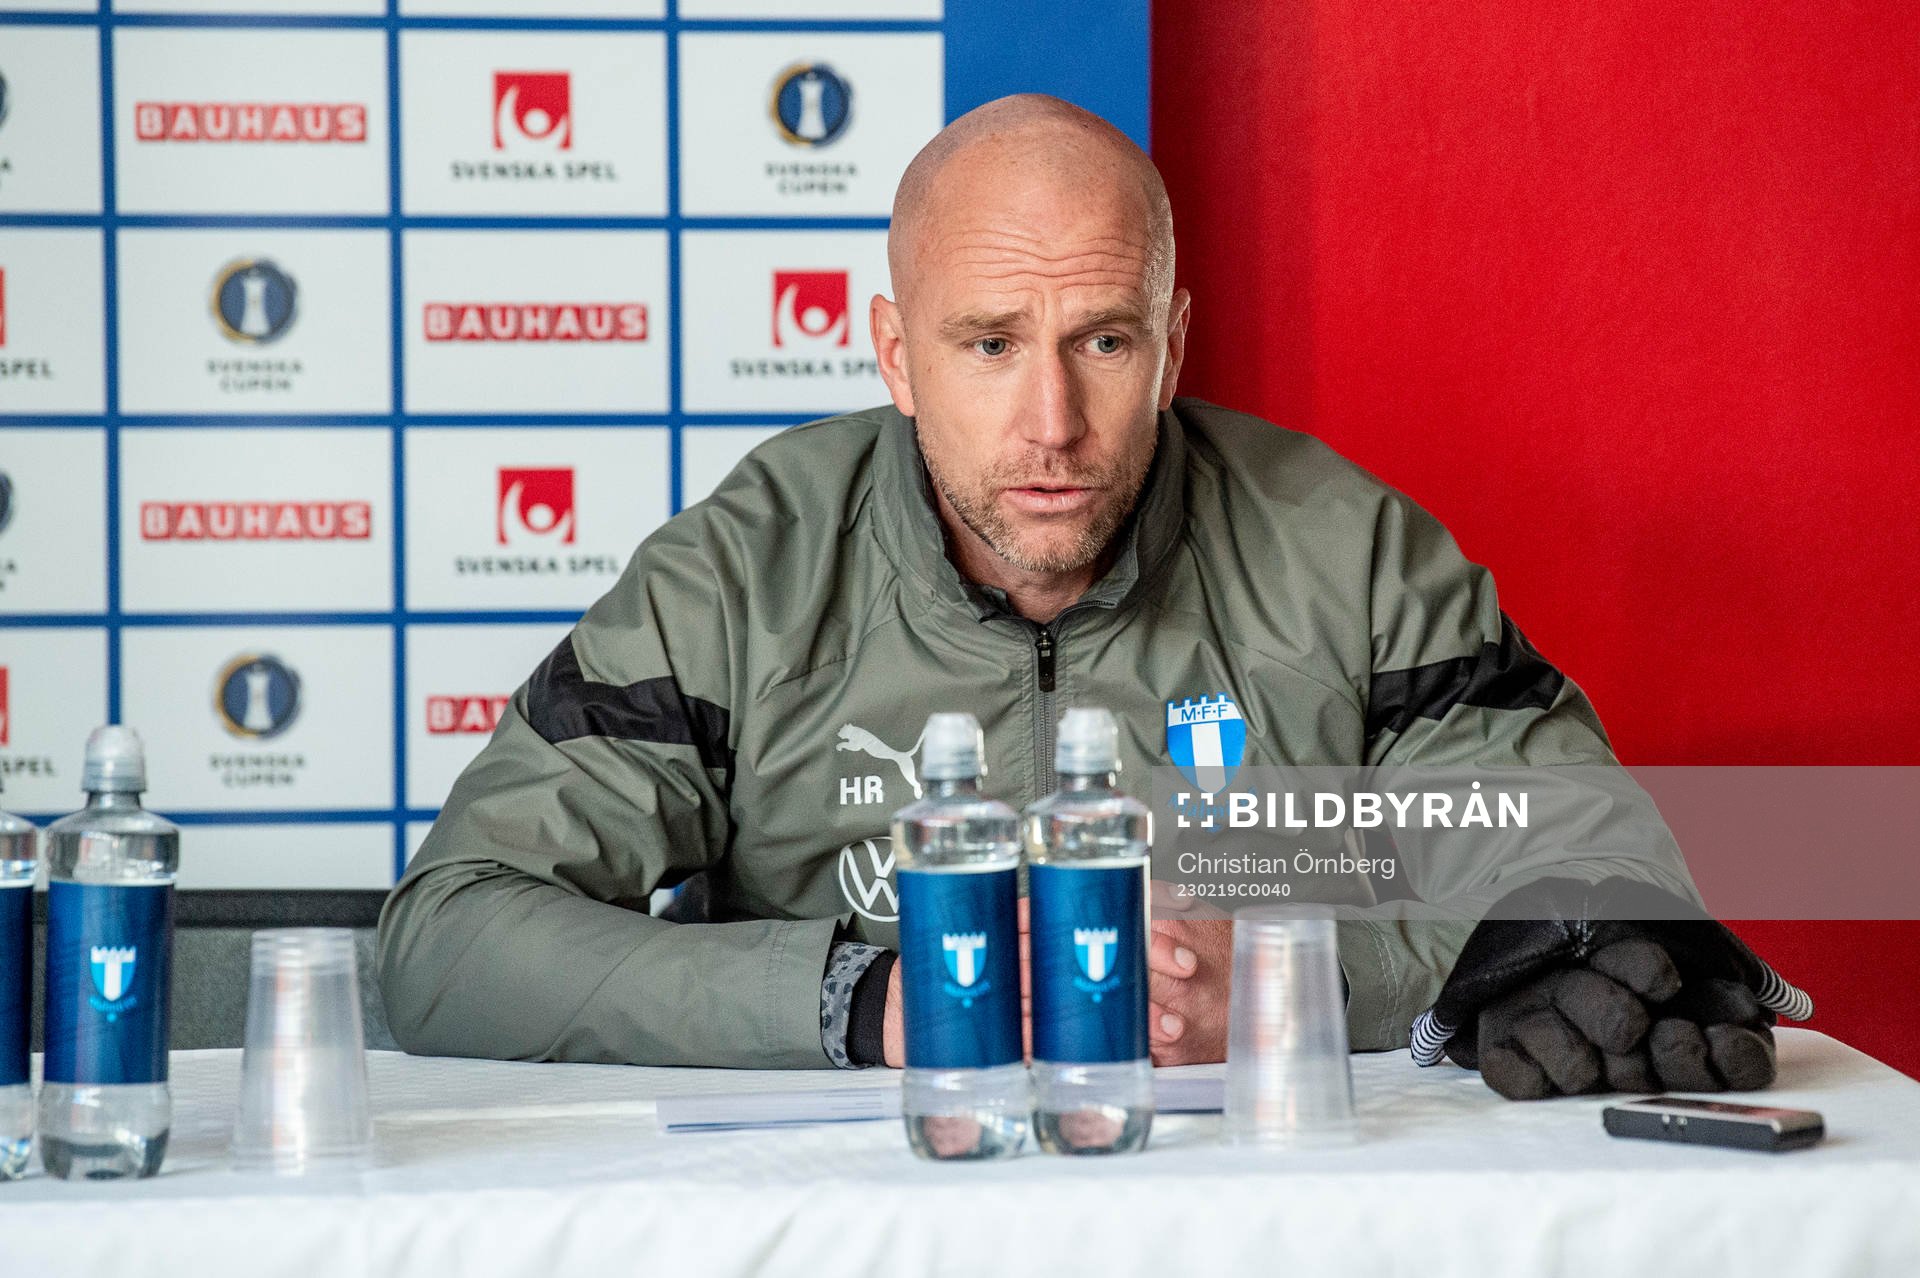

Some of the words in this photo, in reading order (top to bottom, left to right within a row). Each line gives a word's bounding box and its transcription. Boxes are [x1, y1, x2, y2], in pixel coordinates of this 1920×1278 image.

[137, 105, 365, 140] BAUHAUS
[451, 162, 556, 180] SVENSKA
[564, 162, 617, 180] SPEL
[765, 163, 858, 178] SVENSKA
[427, 305, 645, 340] BAUHAUS
[208, 359, 303, 375] SVENSKA
[731, 359, 834, 377] SVENSKA
[842, 359, 878, 377] SPE
[143, 504, 369, 539] BAUHAUS
[455, 556, 559, 575] SVENSKA
[568, 556, 618, 575] SPEL
[210, 754, 305, 770] SVENSKA
[839, 775, 884, 805] HR
